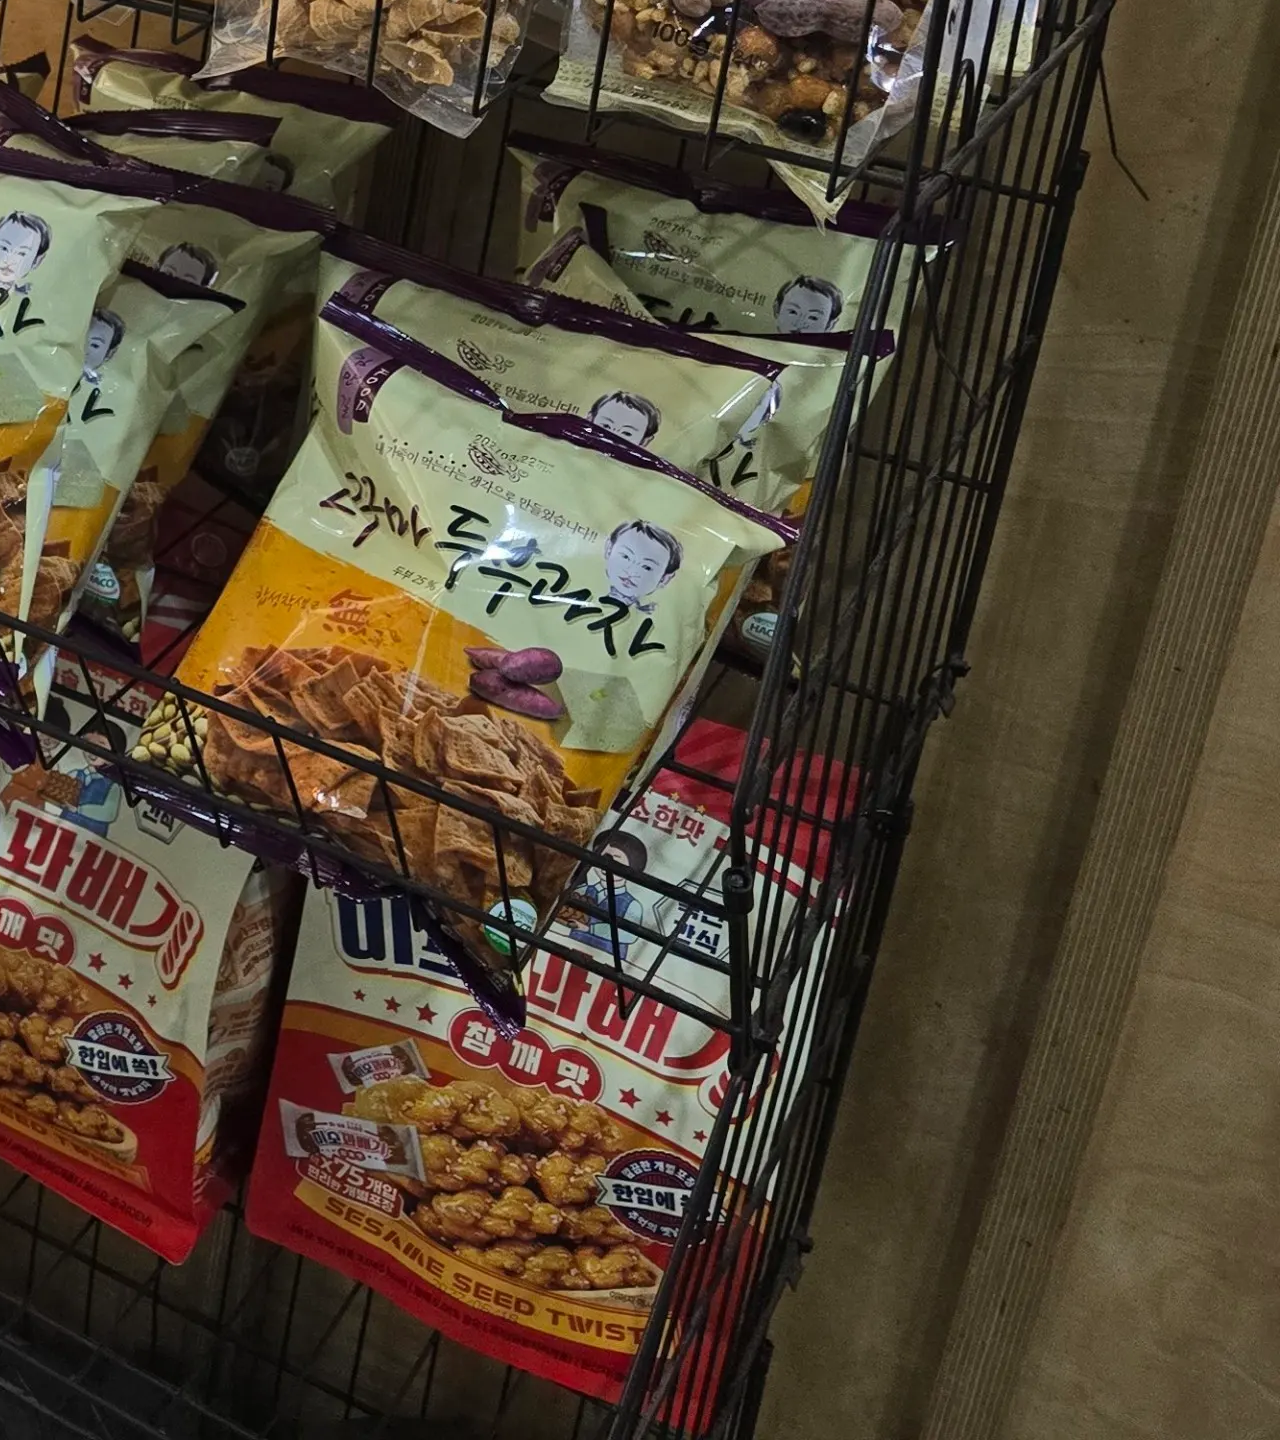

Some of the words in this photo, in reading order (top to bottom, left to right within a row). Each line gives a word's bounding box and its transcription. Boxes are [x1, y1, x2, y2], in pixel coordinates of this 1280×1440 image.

[469, 474, 517, 505] 생각으로
[391, 565, 414, 581] 두부
[434, 503, 667, 658] 두부과자
[630, 796, 705, 847] 소한맛
[77, 1045, 130, 1074] 한입에
[611, 1182, 676, 1212] 한입에
[325, 1196, 445, 1280] SESAME
[452, 1271, 536, 1318] SEED
[545, 1307, 645, 1346] TWIST
